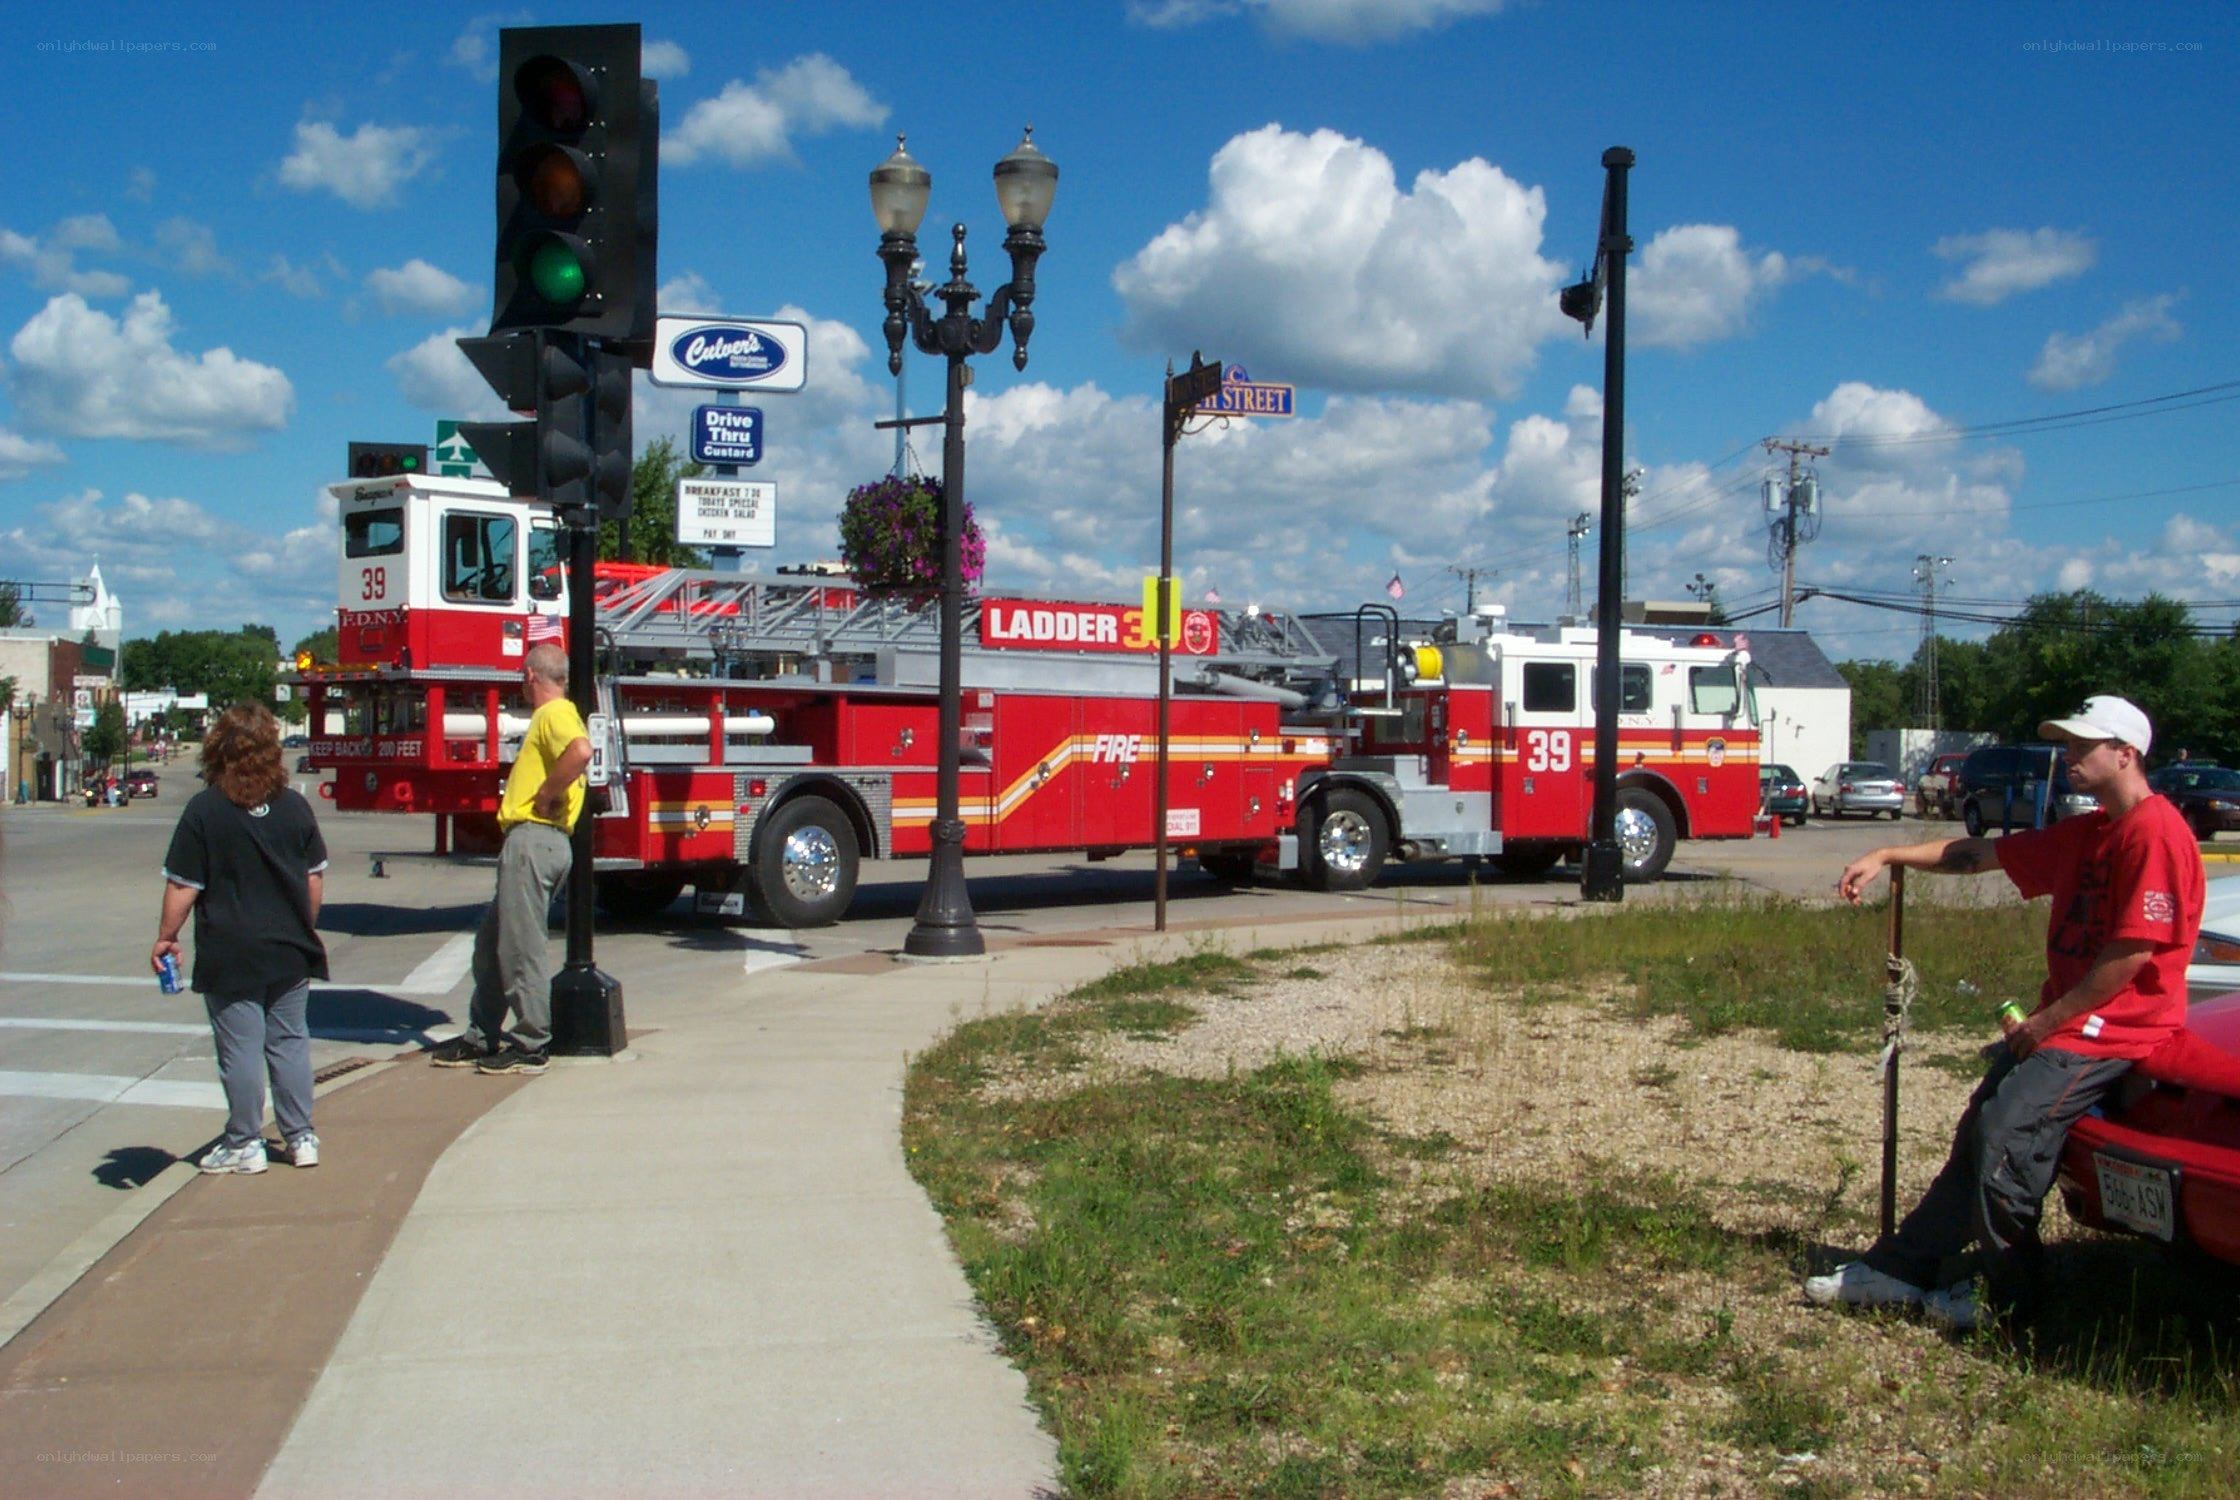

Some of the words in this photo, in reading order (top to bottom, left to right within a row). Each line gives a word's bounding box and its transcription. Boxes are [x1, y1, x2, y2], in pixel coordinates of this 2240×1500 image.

[685, 333, 761, 367] Culver's
[1222, 386, 1287, 412] STREET
[706, 411, 753, 428] Drive
[708, 427, 750, 443] Thru
[703, 446, 754, 459] Custard
[684, 486, 741, 497] BREAKFAST
[362, 566, 386, 601] 39
[990, 608, 1118, 643] LADDER
[397, 741, 422, 756] FEET
[1092, 734, 1141, 763] FIRE
[1527, 730, 1571, 772] 39
